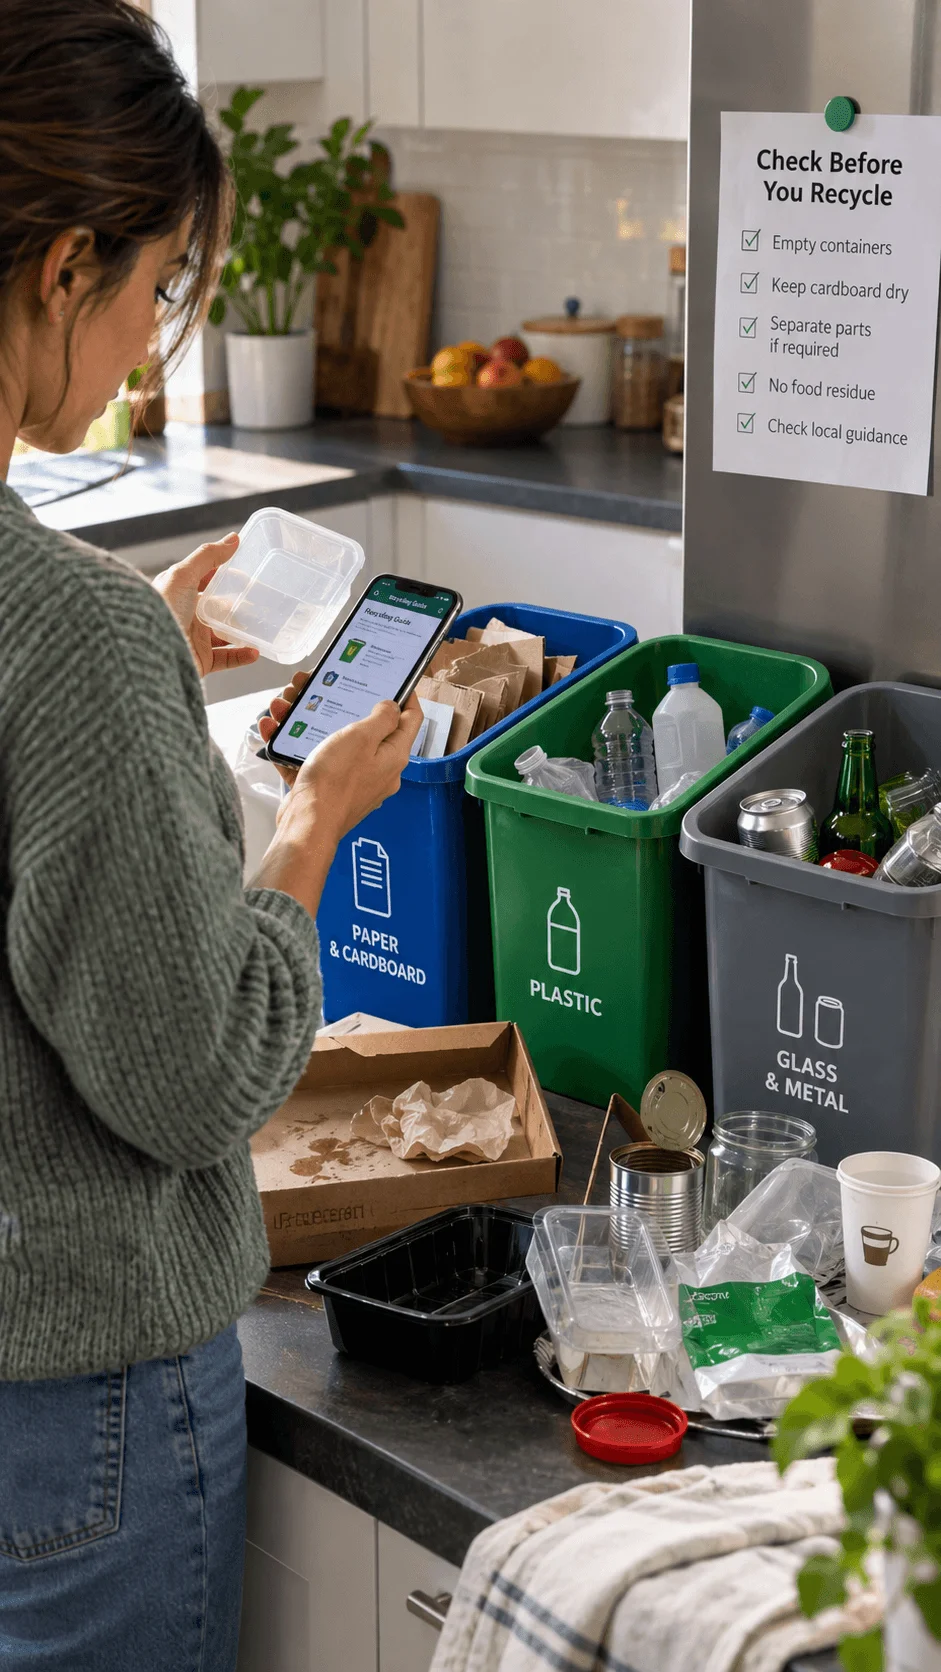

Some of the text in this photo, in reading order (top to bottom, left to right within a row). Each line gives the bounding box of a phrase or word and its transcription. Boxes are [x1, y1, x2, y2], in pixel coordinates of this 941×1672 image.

[757, 149, 903, 175] Check Before
[764, 181, 892, 210] You Recycle
[773, 235, 892, 255] Empty containers
[772, 278, 909, 303] Keep cardboard dry
[771, 316, 871, 339] Separate parts
[770, 339, 838, 359] if required
[769, 378, 875, 401] No food residue
[768, 418, 908, 446] Check local guidance
[353, 925, 399, 954] PAPER
[330, 940, 426, 985] & CARDBOARD
[530, 979, 602, 1017] PLASTIC
[777, 1050, 837, 1083] GLASS
[765, 1072, 848, 1113] & METAL
